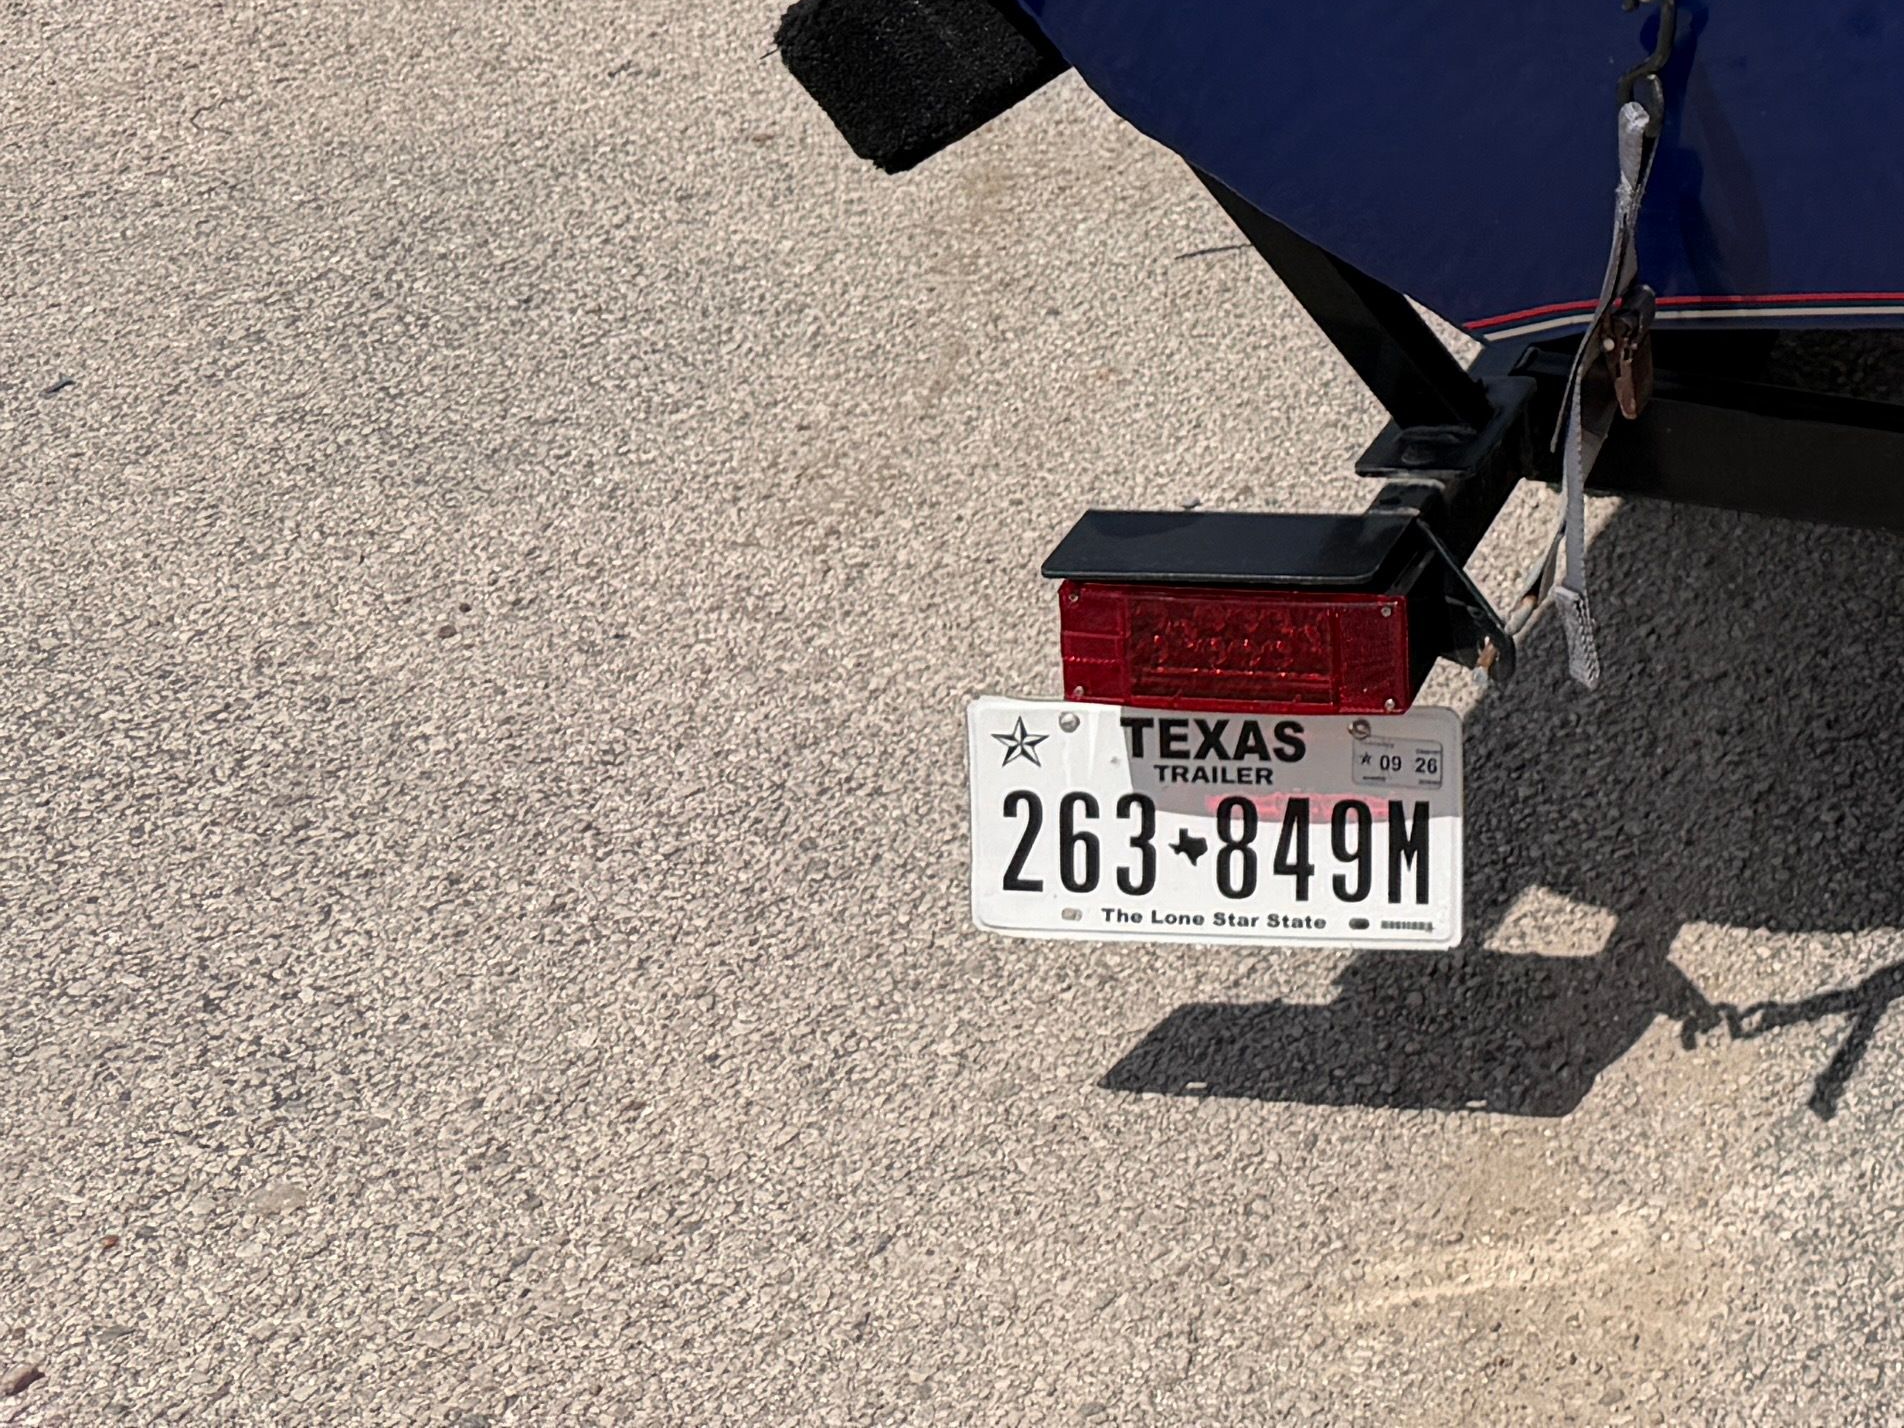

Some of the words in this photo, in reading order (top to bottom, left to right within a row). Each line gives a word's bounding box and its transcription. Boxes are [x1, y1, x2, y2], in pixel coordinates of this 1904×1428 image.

[1120, 716, 1307, 763] TEXAS
[1153, 764, 1274, 786] TRAILER
[1379, 754, 1402, 772] 09
[1415, 757, 1438, 774] 26
[1101, 907, 1143, 924] The
[1151, 909, 1205, 927] Lone
[1213, 911, 1259, 928] Star
[1266, 913, 1327, 930] State
